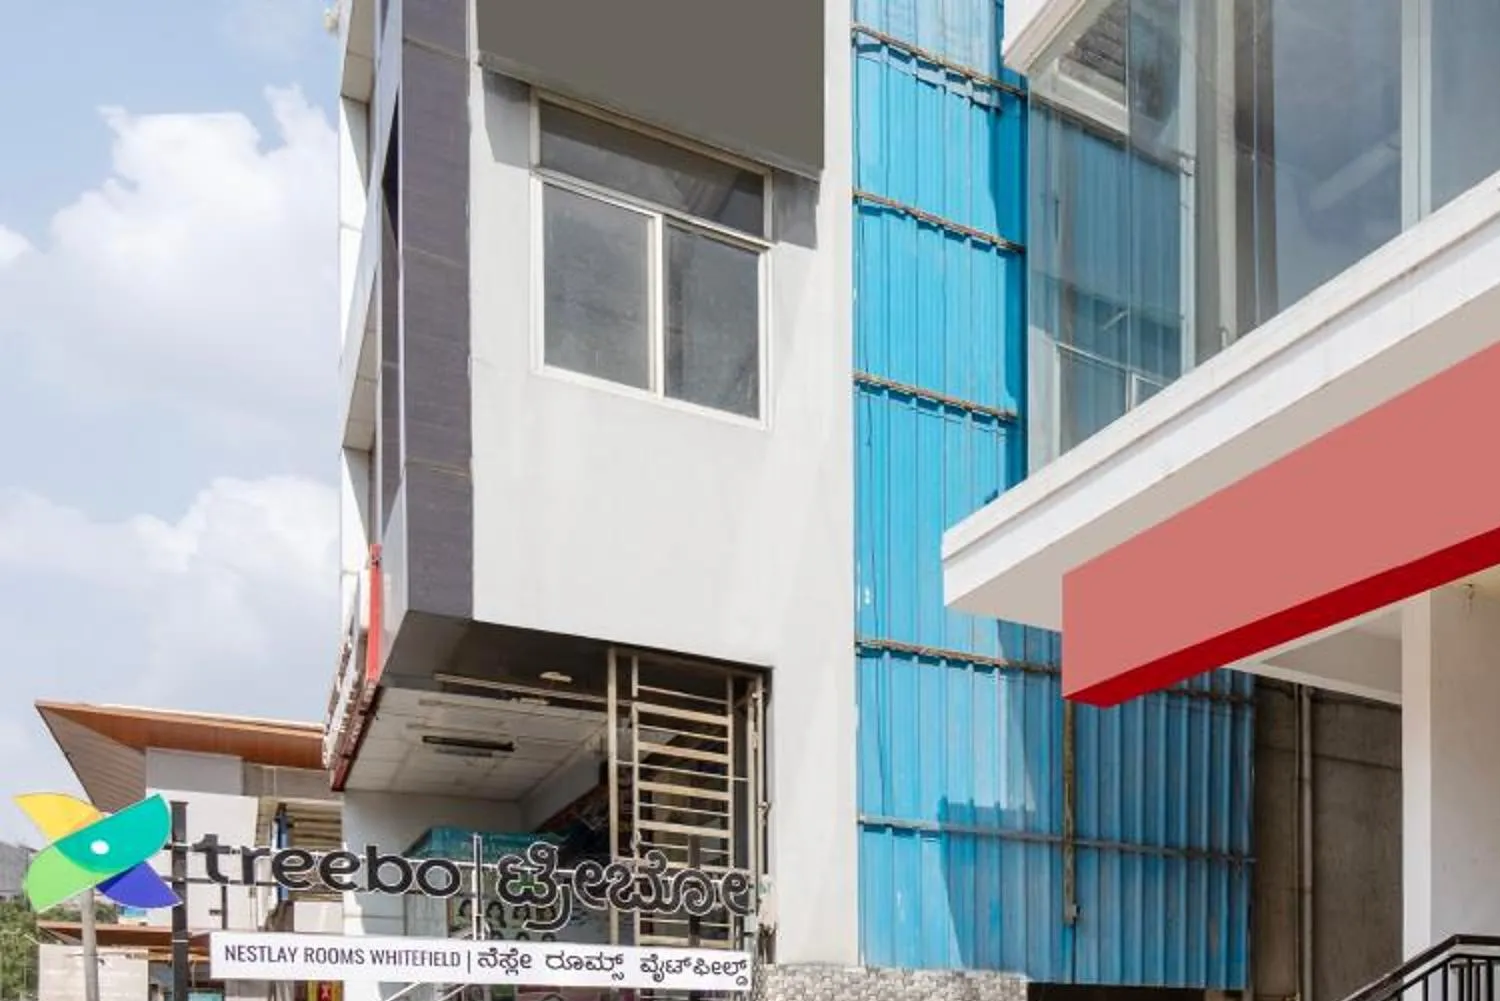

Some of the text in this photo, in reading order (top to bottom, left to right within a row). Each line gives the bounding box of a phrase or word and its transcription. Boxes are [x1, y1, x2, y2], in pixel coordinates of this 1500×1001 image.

[192, 833, 462, 898] treebo
[224, 944, 462, 968] NESTLAY ROOMS WHITEFIELD
